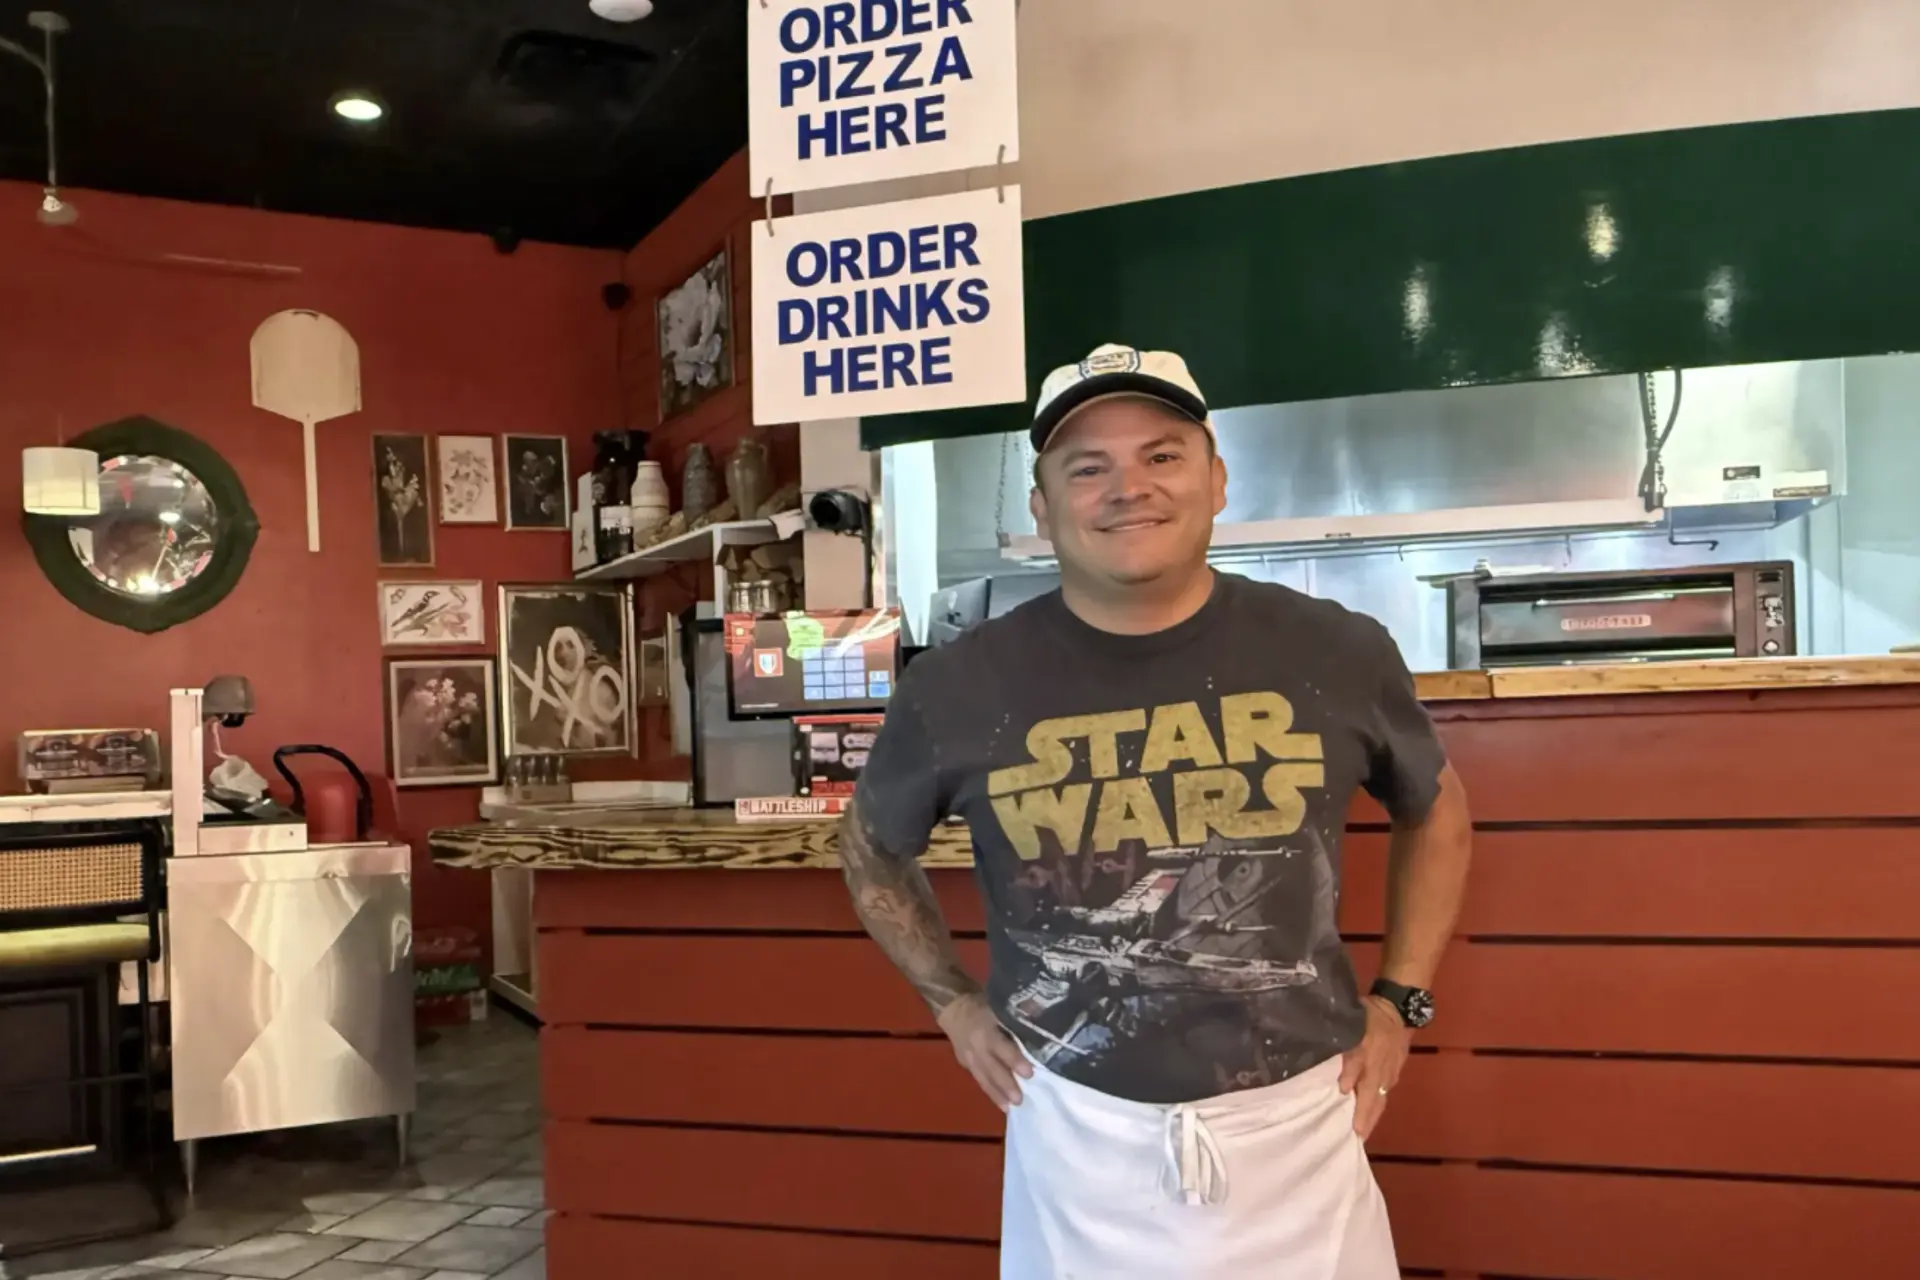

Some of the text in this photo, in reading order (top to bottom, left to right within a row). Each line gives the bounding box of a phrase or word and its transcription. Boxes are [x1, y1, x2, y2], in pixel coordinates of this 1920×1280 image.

[779, 0, 973, 54] ORDER
[779, 35, 974, 108] PIZZA
[797, 93, 947, 161] HERE
[785, 221, 980, 287] ORDER
[777, 278, 991, 345] DRINKS
[803, 336, 954, 397] HERE
[987, 691, 1324, 796] STAR
[989, 762, 1325, 861] WARS
